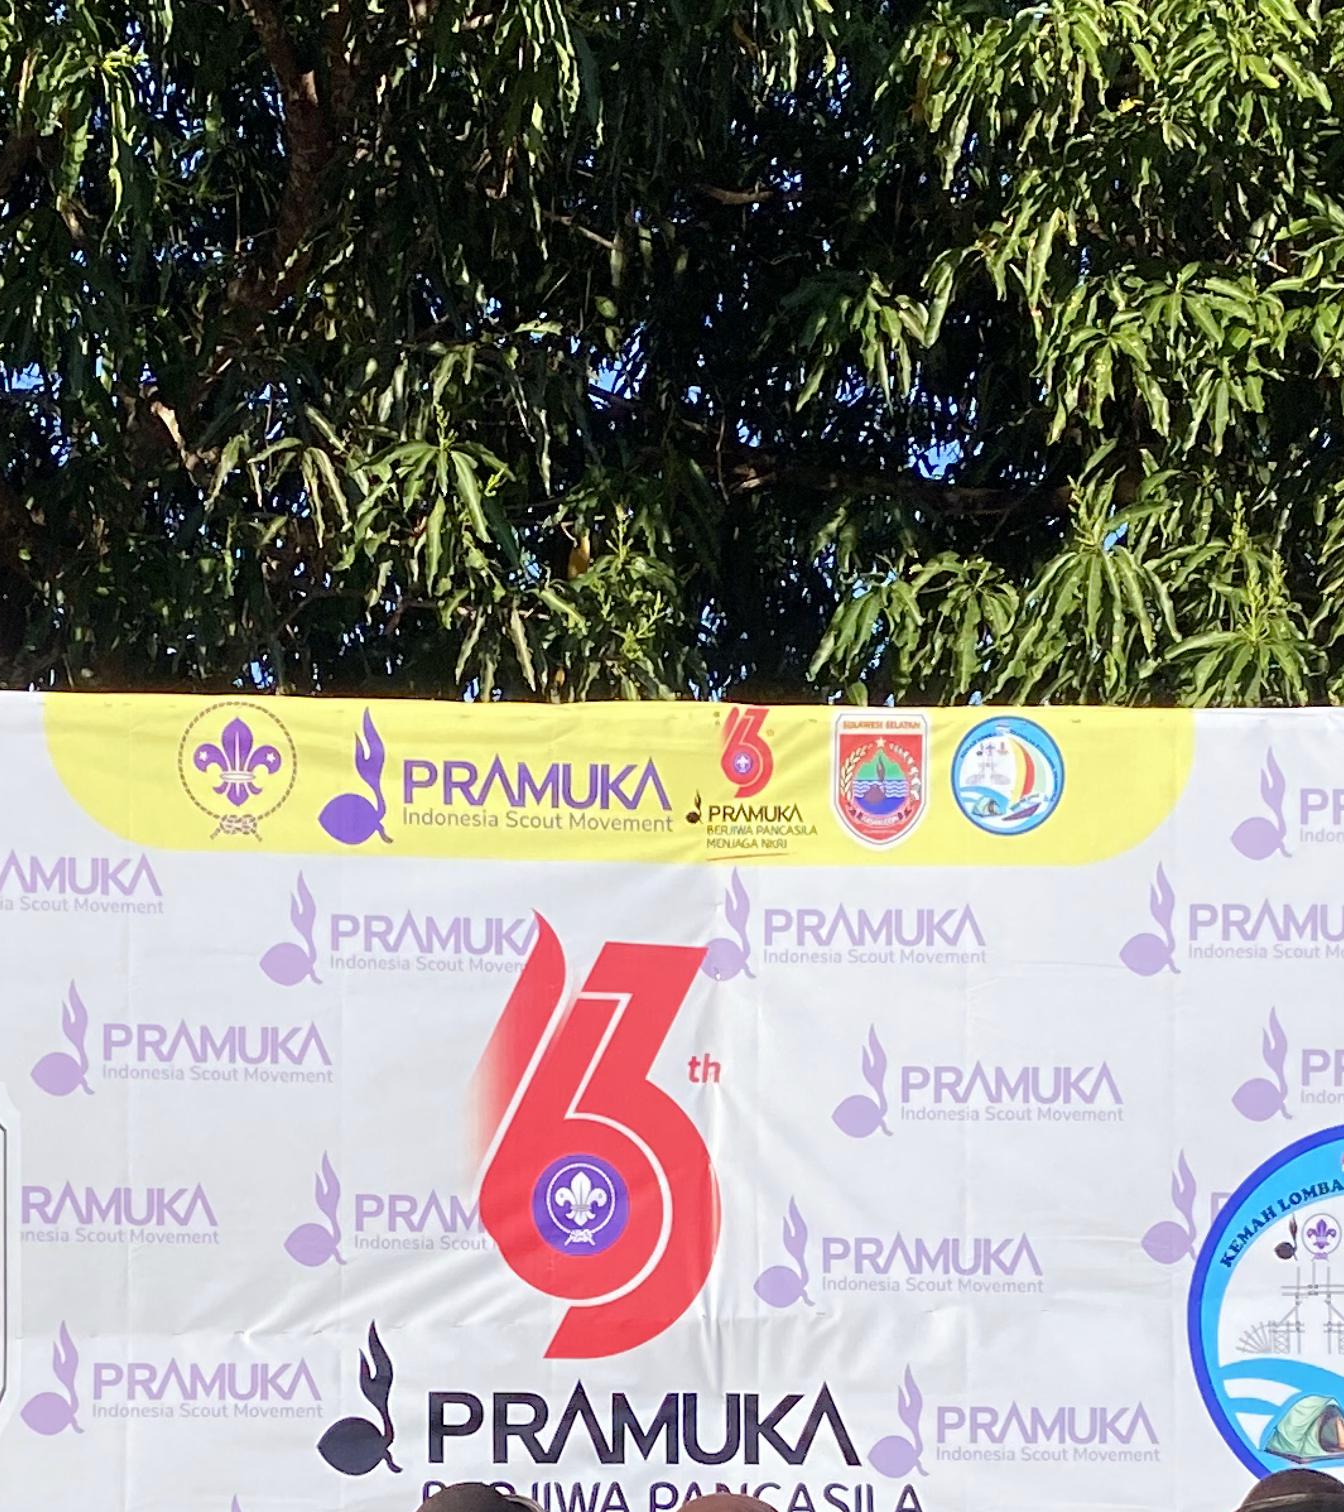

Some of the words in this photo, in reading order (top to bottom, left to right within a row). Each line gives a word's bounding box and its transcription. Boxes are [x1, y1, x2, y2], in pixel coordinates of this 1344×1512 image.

[403, 755, 672, 811] PRAMUKA
[402, 808, 498, 828] Indonesia
[505, 810, 563, 830] Scout
[569, 812, 673, 832] Movement
[708, 803, 803, 822] PRAMUKA
[707, 825, 753, 836] BERJIWA
[756, 825, 817, 836] PANCASILA
[707, 838, 758, 849] MENJAGA
[19, 897, 69, 913] Scout
[74, 898, 163, 914] Movement
[763, 904, 986, 947] PRAMUKA
[330, 954, 410, 970] Indonesia
[416, 956, 464, 971] Scout
[763, 949, 842, 965] Indonesia
[847, 949, 897, 965] Scout
[900, 949, 987, 965] Movement
[1188, 946, 1268, 960] Indonesia
[1272, 946, 1320, 960] Scout
[102, 1021, 332, 1066] PRAMUKA
[102, 1065, 184, 1081] Indonesia
[189, 1066, 239, 1081] Scout
[244, 1066, 333, 1082] Movement
[687, 1053, 722, 1084] th
[901, 1061, 1123, 1104] PRAMUKA
[901, 1106, 980, 1122] Indonesia
[985, 1106, 1032, 1122] Scout
[1037, 1106, 1124, 1122] Movement
[21, 1180, 218, 1227] RAMUKA
[355, 1189, 484, 1233] PRAM
[1220, 1205, 1277, 1267] KEMAH
[1278, 1179, 1344, 1212] LOMBA
[21, 1228, 69, 1242] nesia
[75, 1228, 125, 1243] Scout
[130, 1229, 220, 1244] Movement
[354, 1235, 434, 1249] Indonesia
[440, 1235, 487, 1250] Scout
[823, 1233, 1044, 1279] PRAMUKA
[822, 1277, 900, 1292] Indonesia
[906, 1277, 953, 1293] Scout
[958, 1278, 1044, 1293] Movement
[92, 1358, 322, 1402] PRAMUKA
[92, 1403, 174, 1419] Indonesia
[179, 1403, 229, 1419] Scout
[233, 1403, 323, 1419] Movement
[428, 1378, 861, 1466] PRAMUKA
[935, 1402, 1159, 1446] PRAMUKA
[936, 1447, 1016, 1462] Indonesia
[1020, 1447, 1069, 1462] Scout
[1071, 1447, 1160, 1462] Movement
